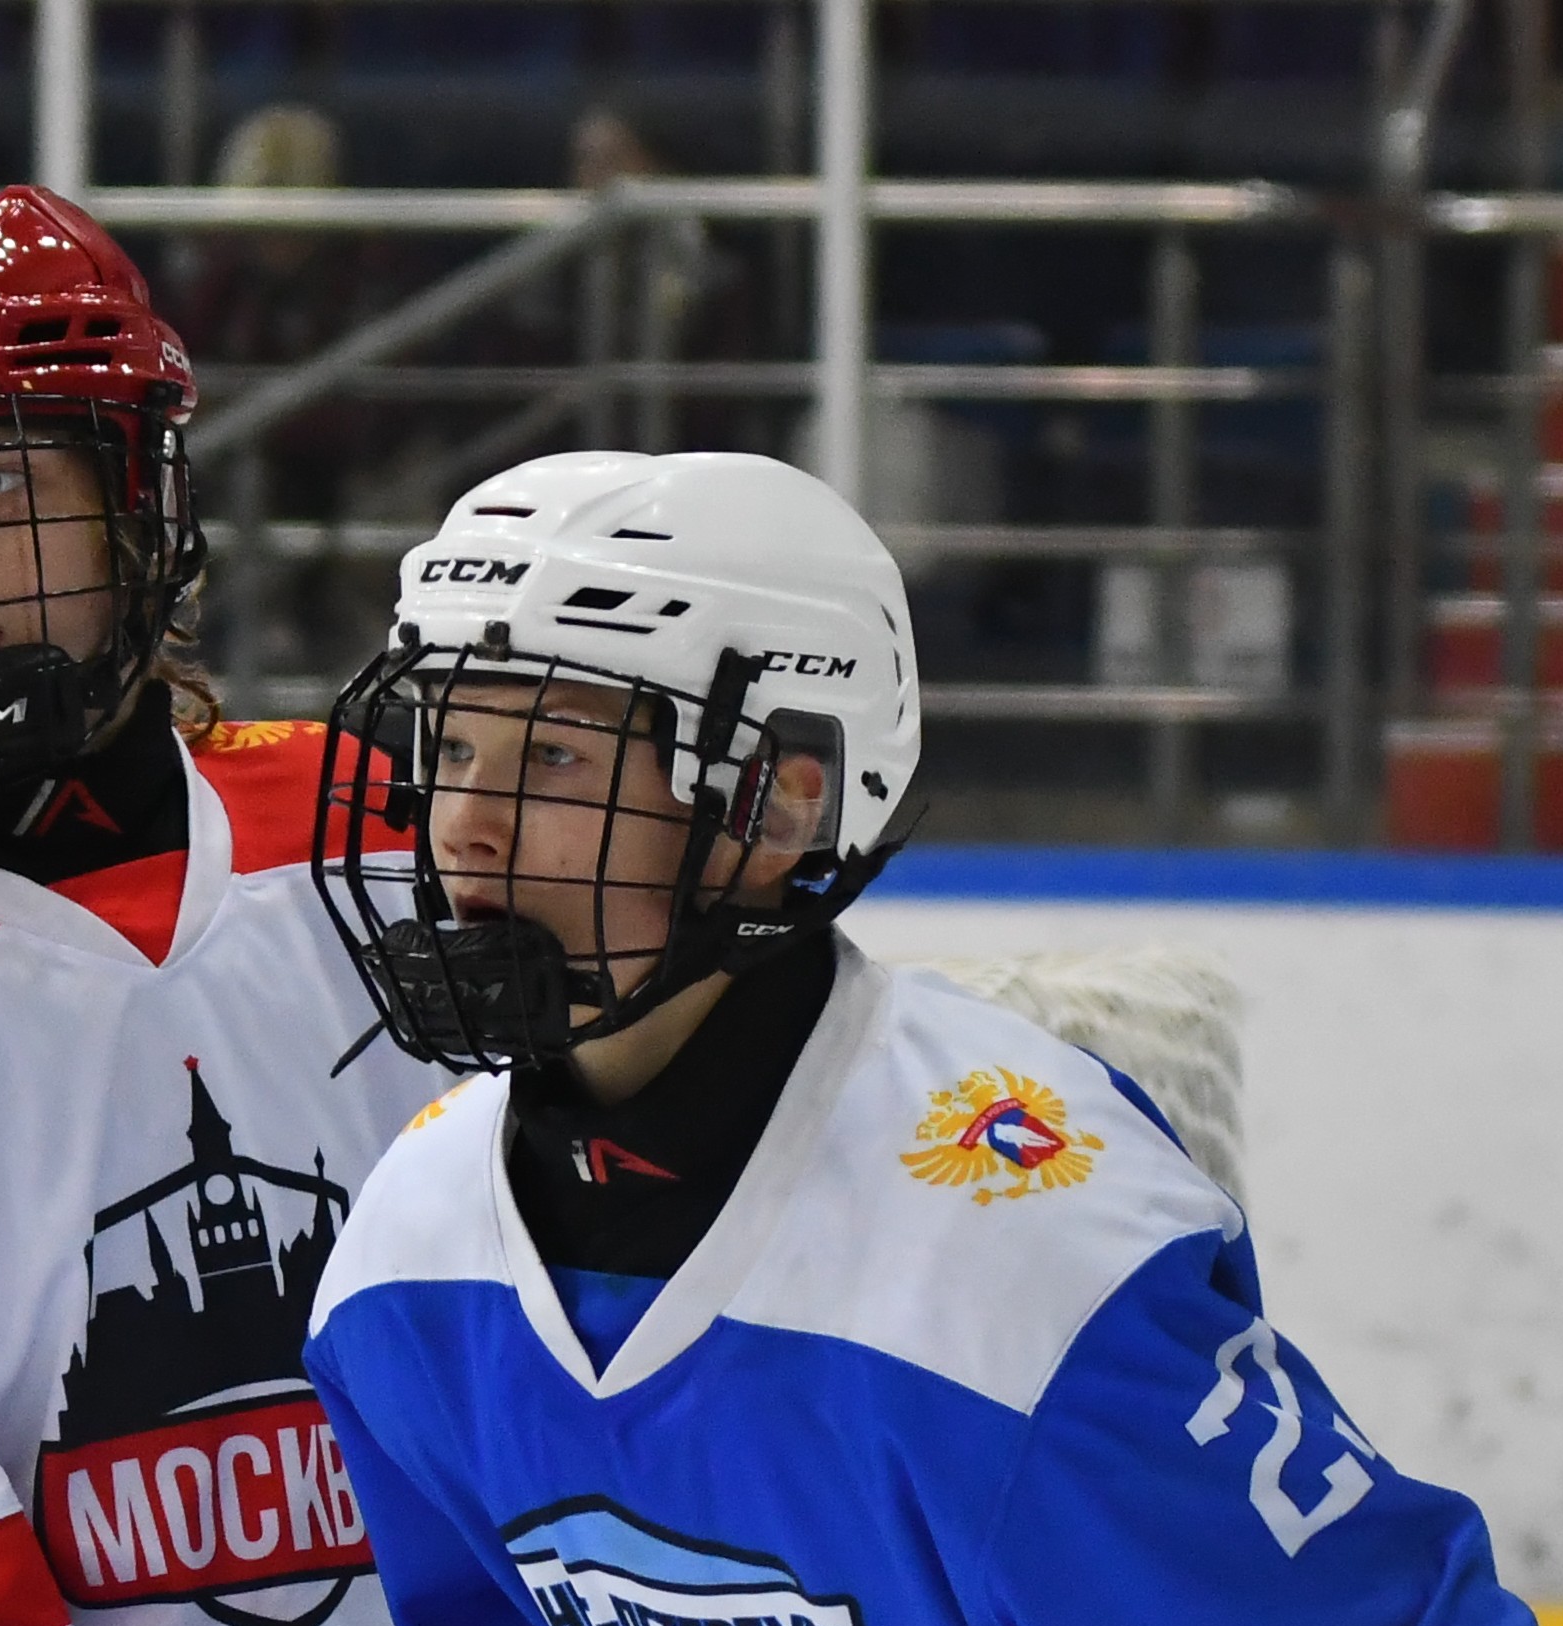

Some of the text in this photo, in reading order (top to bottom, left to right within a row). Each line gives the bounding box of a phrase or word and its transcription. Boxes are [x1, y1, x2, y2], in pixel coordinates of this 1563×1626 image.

[420, 558, 531, 585] CCM
[758, 649, 858, 679] CCM
[1185, 1315, 1378, 1559] 2
[67, 1423, 366, 1587] МОСКВ
